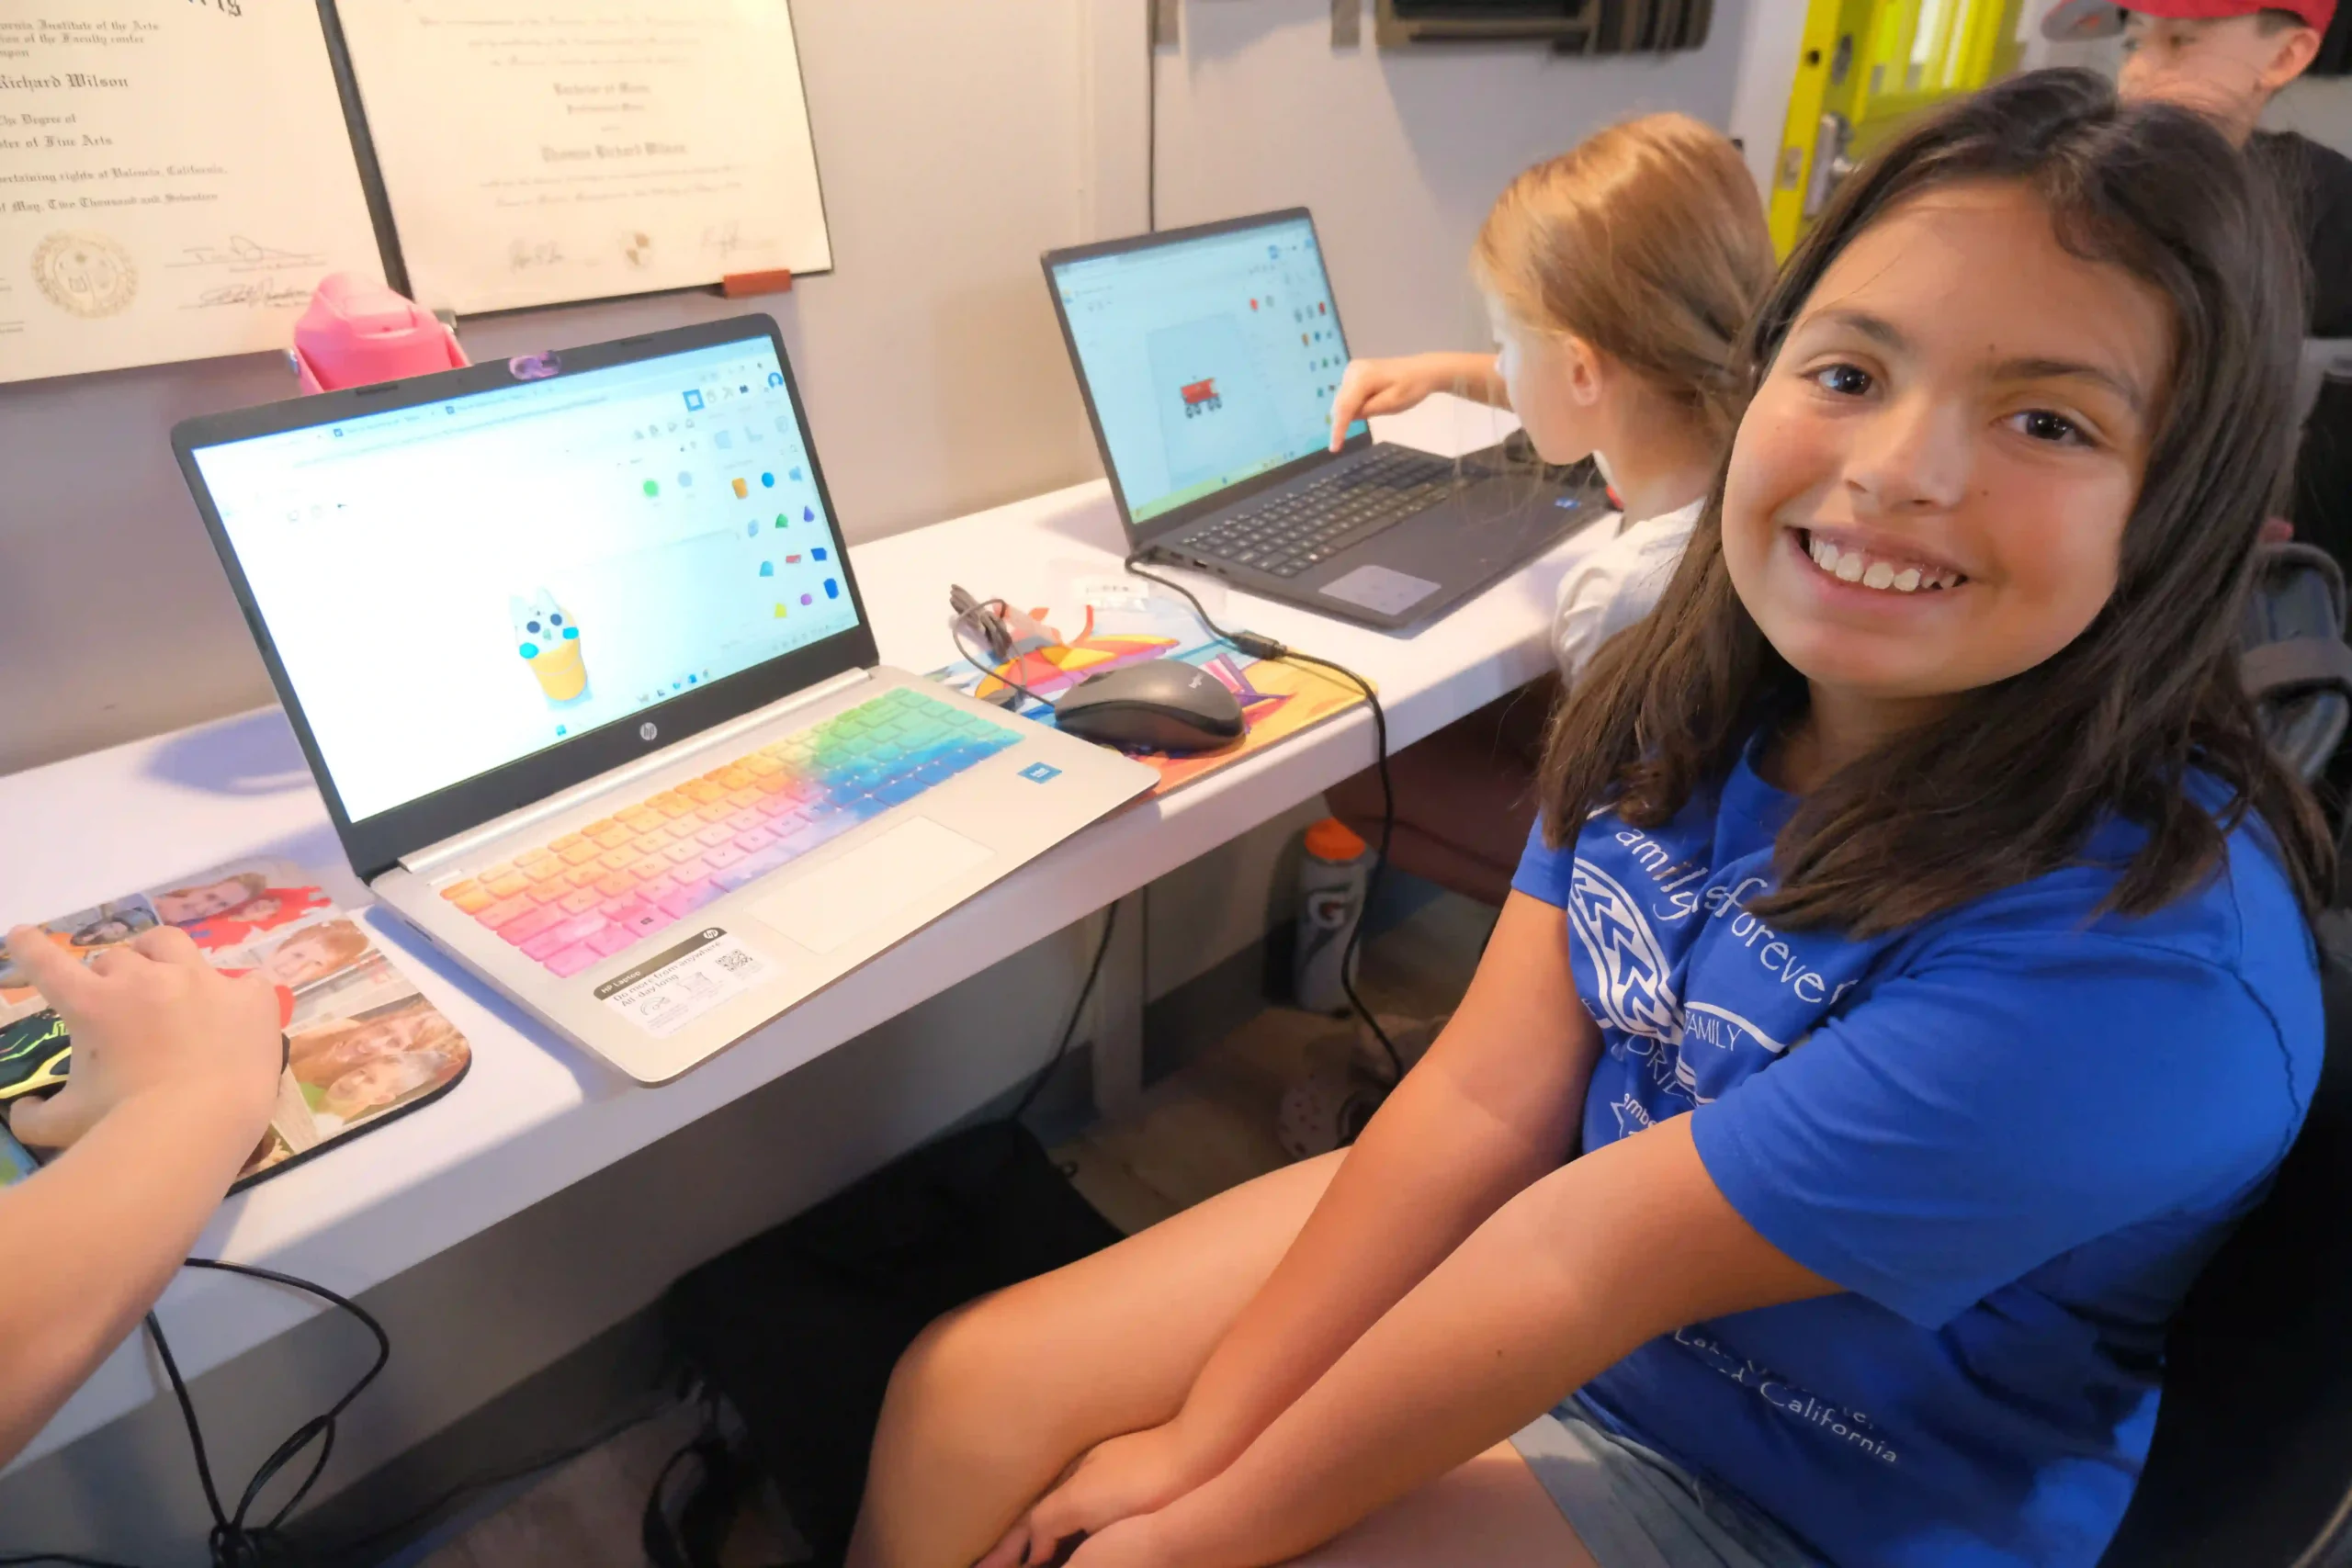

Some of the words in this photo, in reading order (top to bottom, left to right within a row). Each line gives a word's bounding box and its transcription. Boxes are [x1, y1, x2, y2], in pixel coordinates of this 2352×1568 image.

[65, 73, 130, 89] Wilson
[20, 112, 62, 129] Degree
[613, 970, 641, 987] Laptop
[629, 977, 655, 993] more
[1760, 1382, 1896, 1463] California
